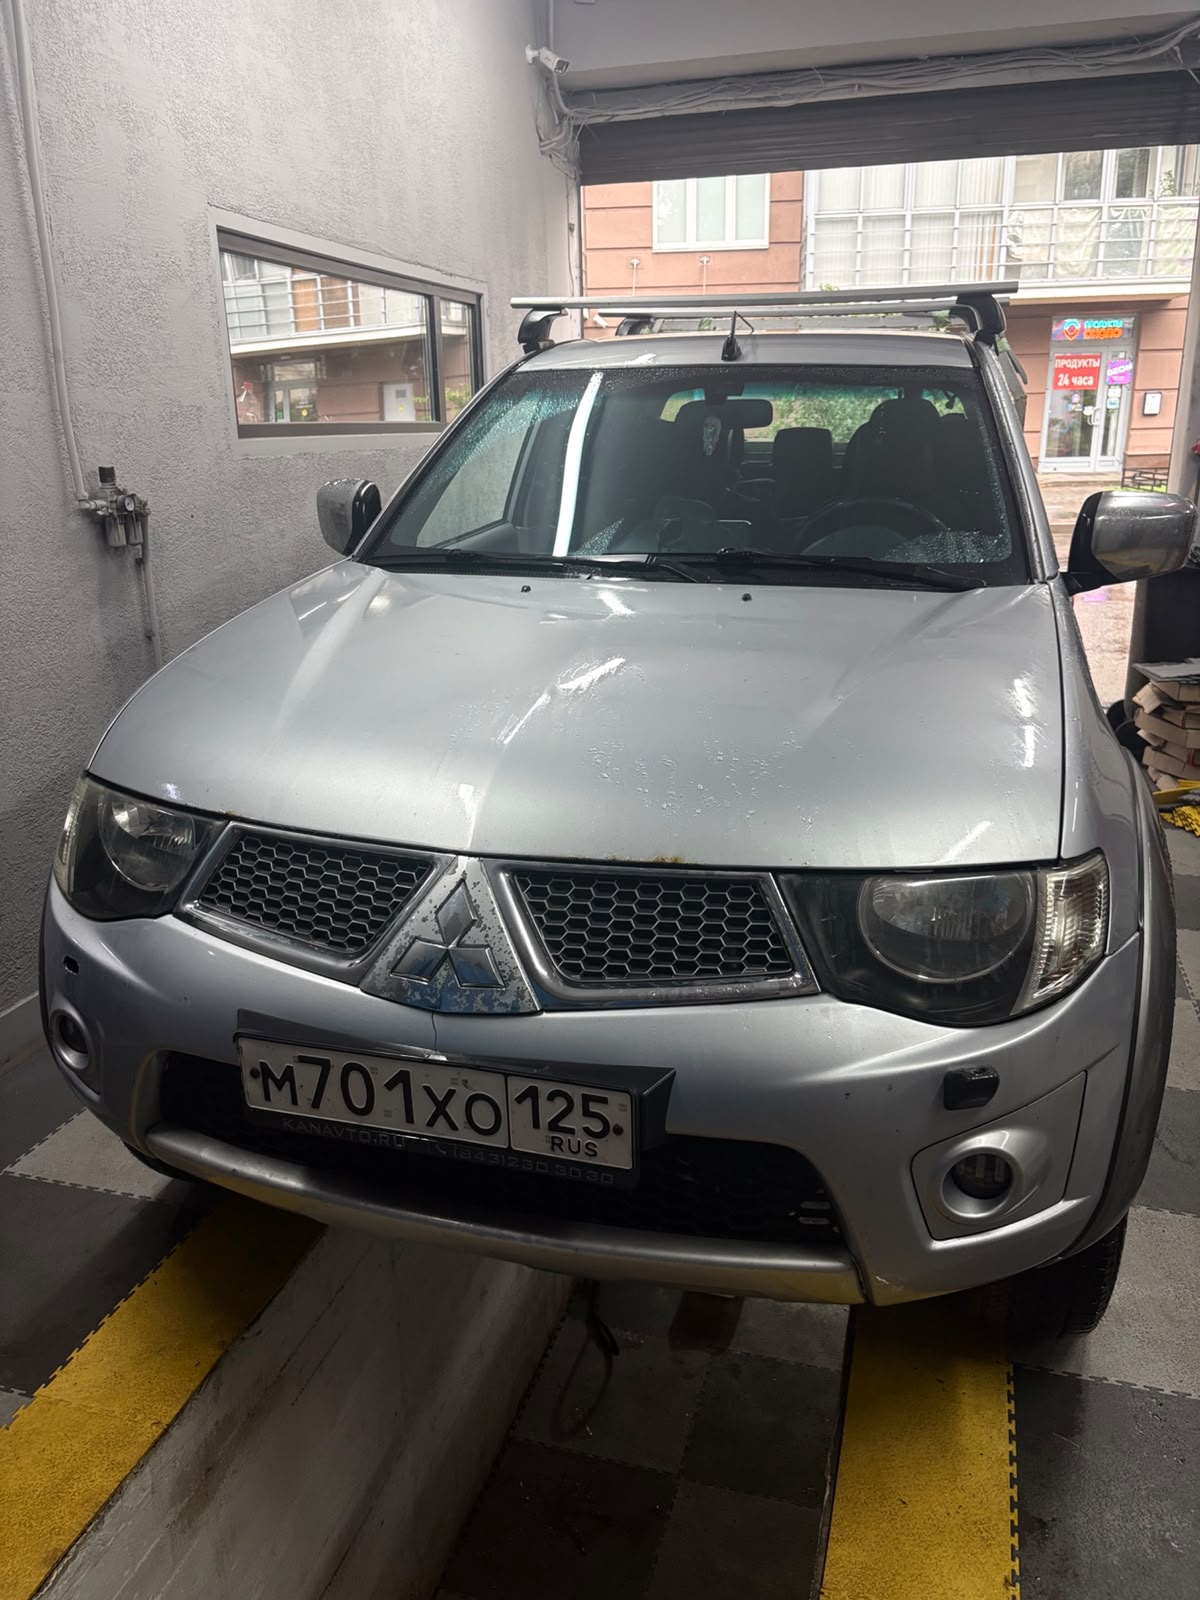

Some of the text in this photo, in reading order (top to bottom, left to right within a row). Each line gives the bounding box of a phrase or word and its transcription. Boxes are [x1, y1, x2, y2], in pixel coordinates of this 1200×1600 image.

[1055, 358, 1100, 369] ПРОДУКТЫ
[1057, 373, 1094, 386] 24 часа
[514, 1085, 610, 1139] 125
[282, 1117, 405, 1147] KANAVTO.RU
[550, 1136, 598, 1157] RUS
